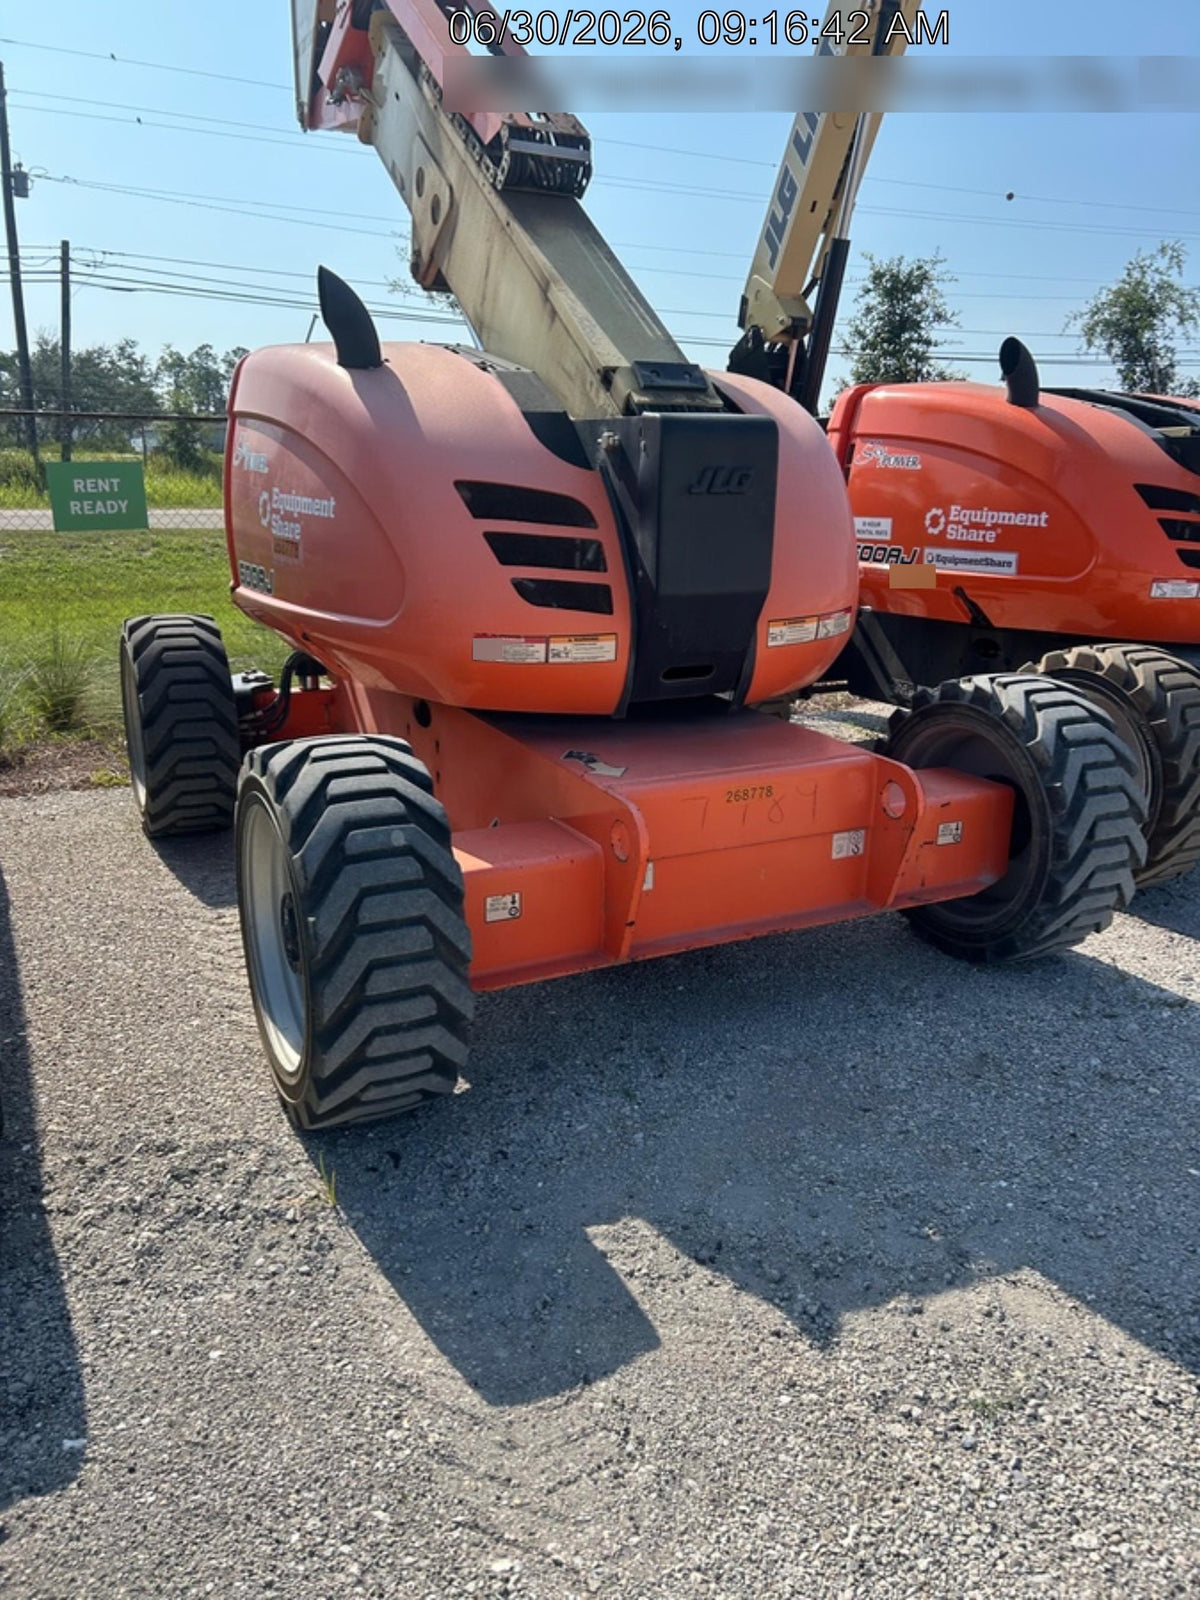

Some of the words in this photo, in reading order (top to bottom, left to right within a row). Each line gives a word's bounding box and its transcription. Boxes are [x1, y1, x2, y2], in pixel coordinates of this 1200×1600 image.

[764, 163, 798, 272] JLG
[73, 478, 121, 493] RENT
[686, 464, 753, 497] JLG
[70, 500, 129, 515] READY
[271, 487, 336, 518] Equipment
[948, 504, 1049, 527] Equipment
[271, 514, 302, 540] Share
[945, 524, 998, 542] Share
[856, 544, 919, 565] 00AJ
[935, 553, 1013, 568] EquipmentShare
[726, 785, 774, 804] 268778
